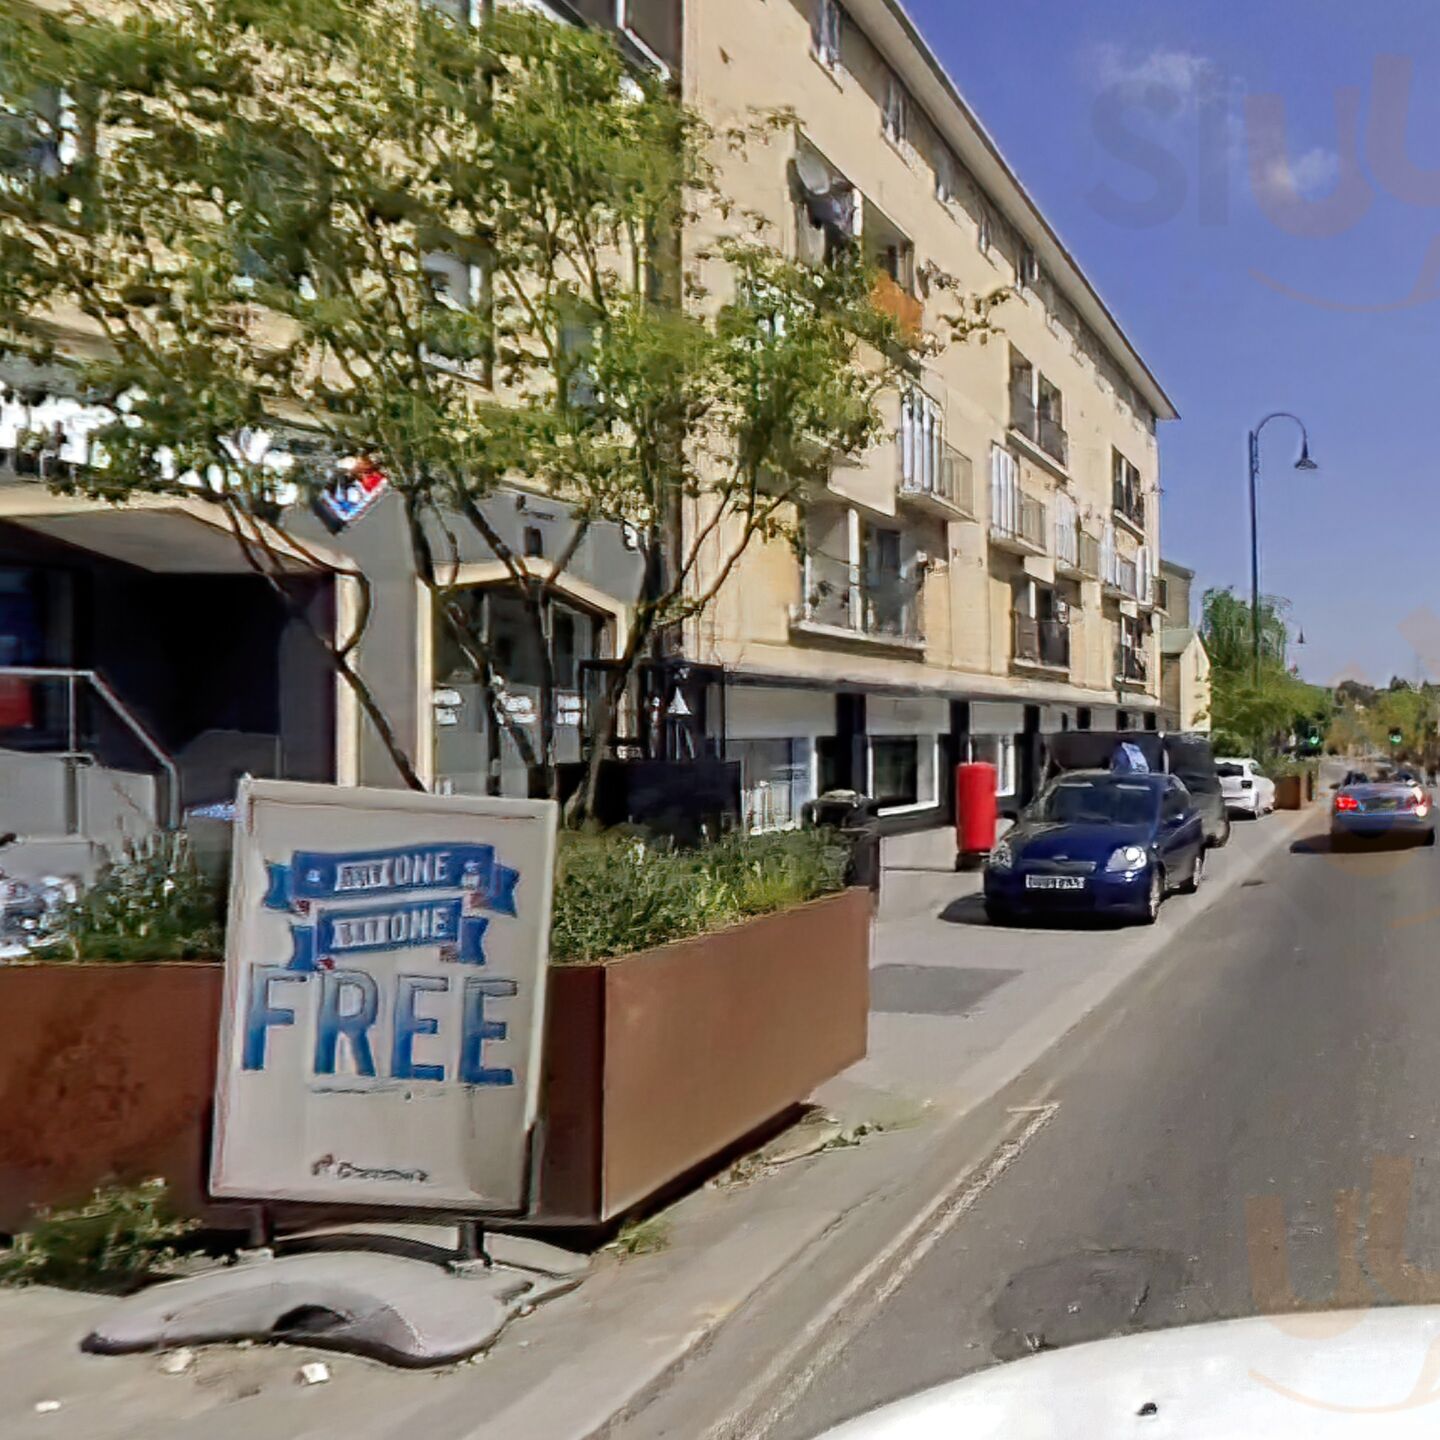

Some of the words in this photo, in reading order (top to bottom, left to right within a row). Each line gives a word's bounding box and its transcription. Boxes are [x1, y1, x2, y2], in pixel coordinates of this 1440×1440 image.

[395, 852, 451, 886] ONE
[391, 908, 449, 941] ONE
[242, 962, 518, 1086] FREE
